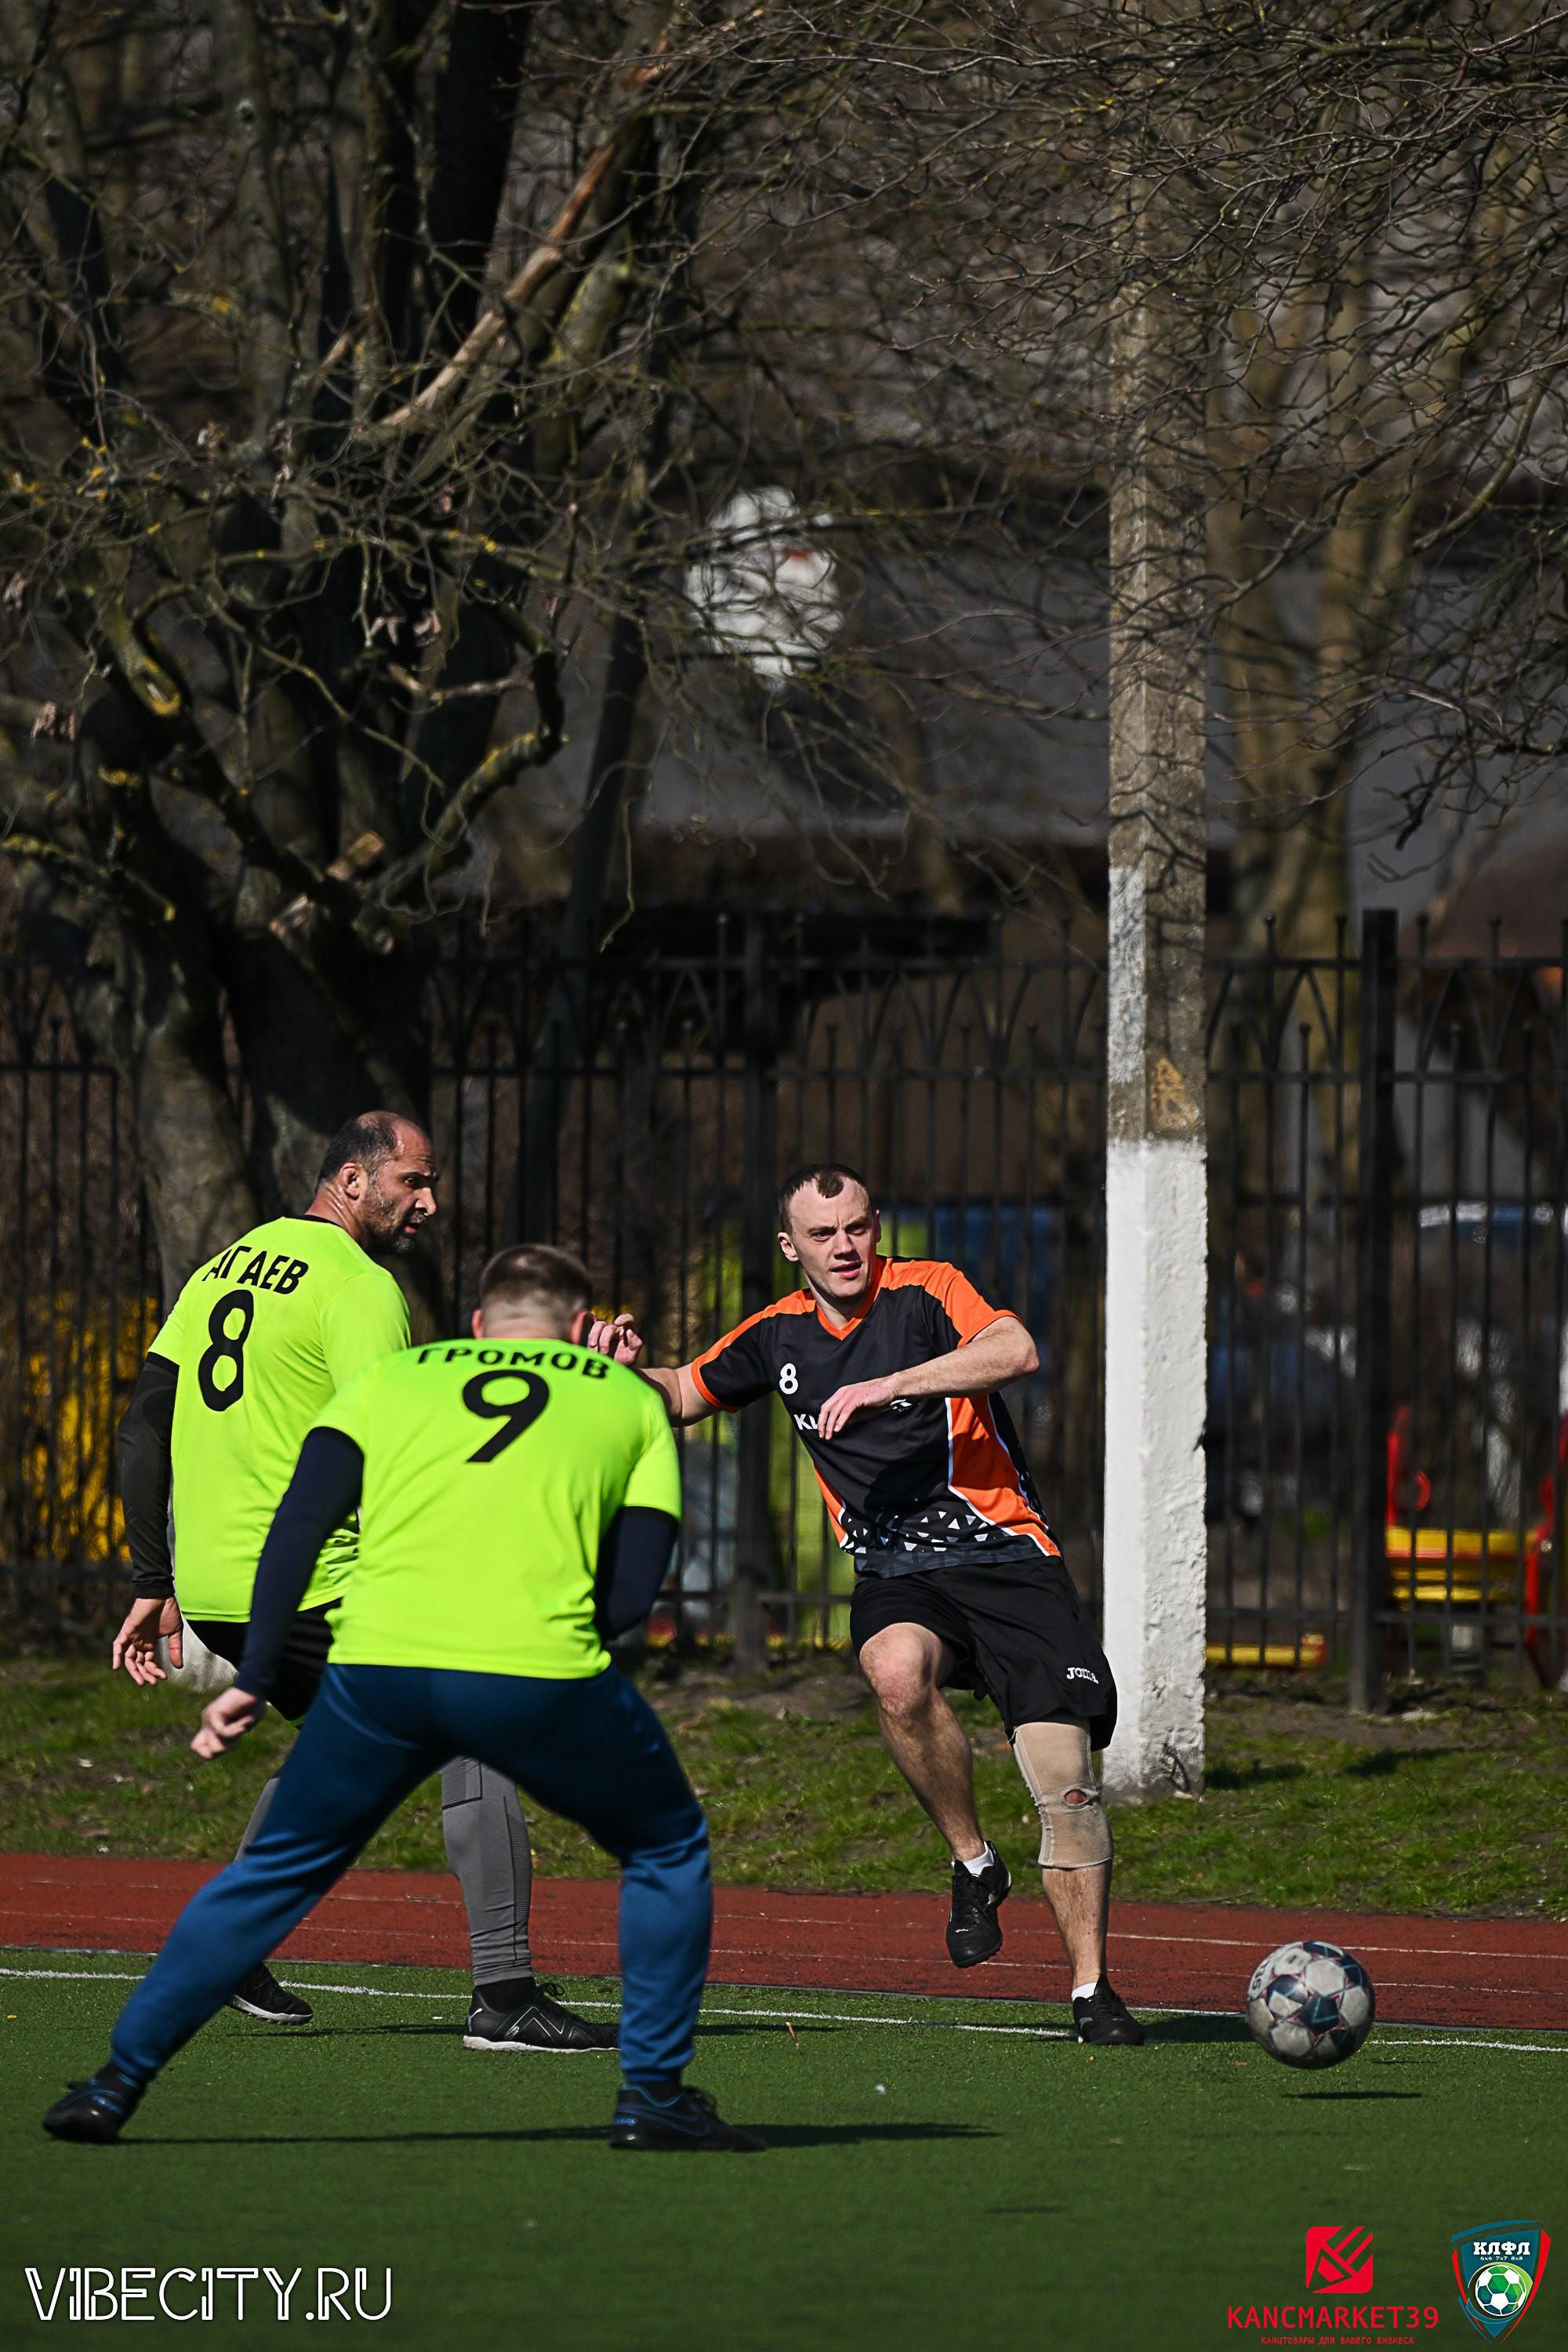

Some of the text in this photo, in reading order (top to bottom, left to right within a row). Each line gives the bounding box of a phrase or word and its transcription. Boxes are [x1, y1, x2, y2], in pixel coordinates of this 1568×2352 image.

[201, 1245, 309, 1295] АГАЕВ
[198, 1289, 255, 1412] 8
[417, 1348, 610, 1379] ГРОМОВ
[779, 1363, 799, 1395] 8
[462, 1369, 551, 1464] 9
